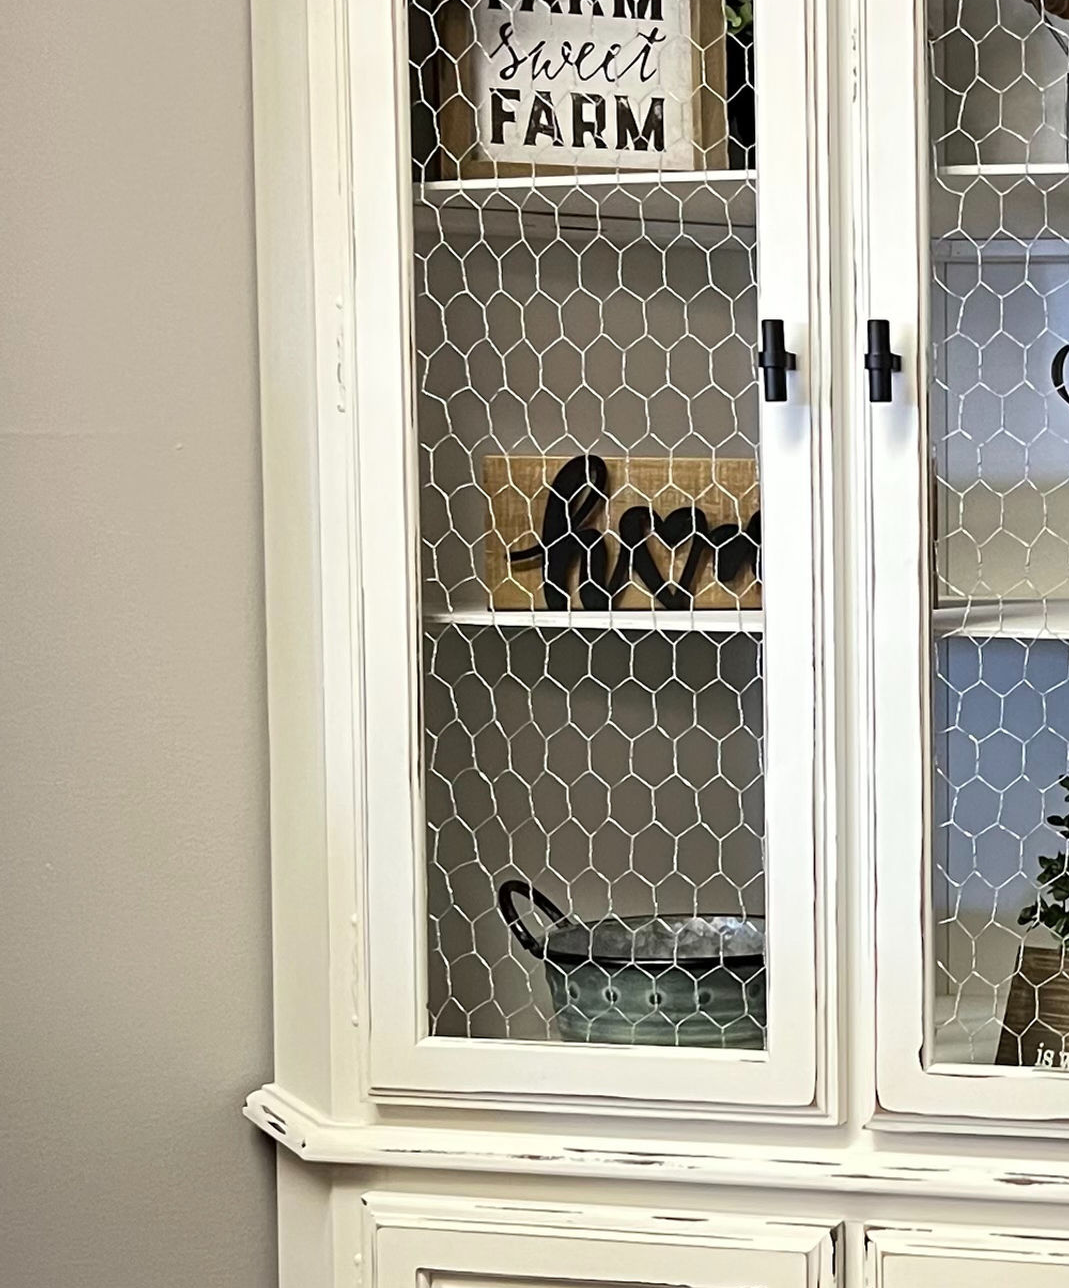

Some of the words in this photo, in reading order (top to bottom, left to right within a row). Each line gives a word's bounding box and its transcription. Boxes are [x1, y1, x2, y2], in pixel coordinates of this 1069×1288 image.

[489, 21, 667, 83] sweet
[489, 87, 667, 153] FARM
[1035, 1042, 1055, 1067] is
